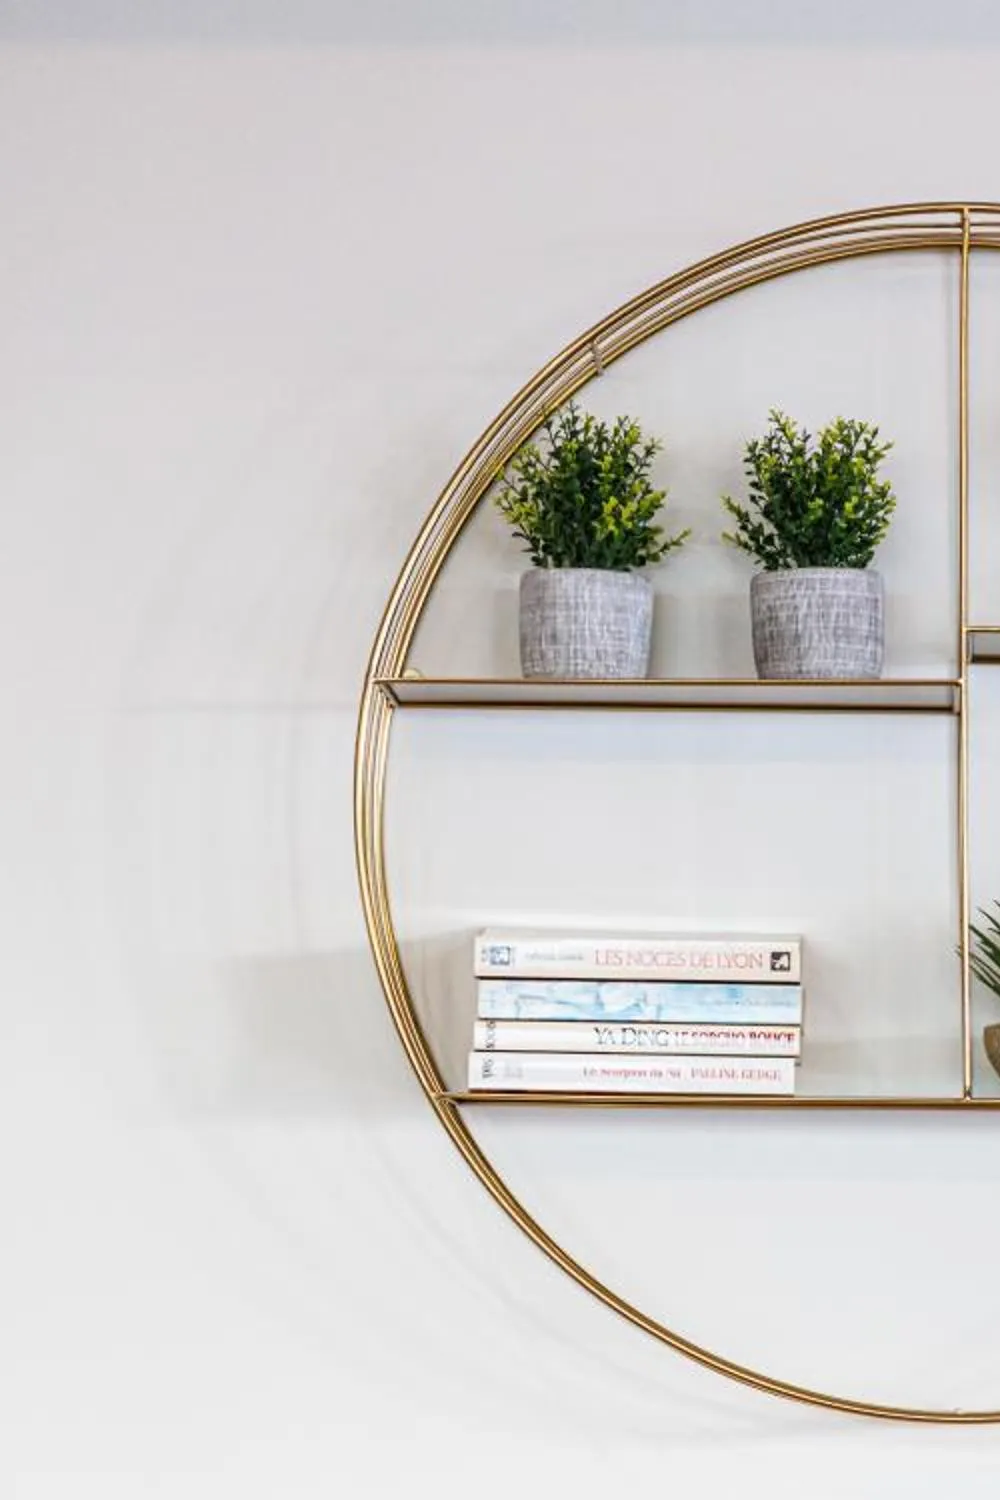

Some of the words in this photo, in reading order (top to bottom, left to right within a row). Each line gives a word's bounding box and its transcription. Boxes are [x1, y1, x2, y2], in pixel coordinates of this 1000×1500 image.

[595, 949, 623, 966] LES
[627, 950, 686, 967] NOCES
[691, 951, 714, 968] DE
[718, 952, 763, 969] LYON
